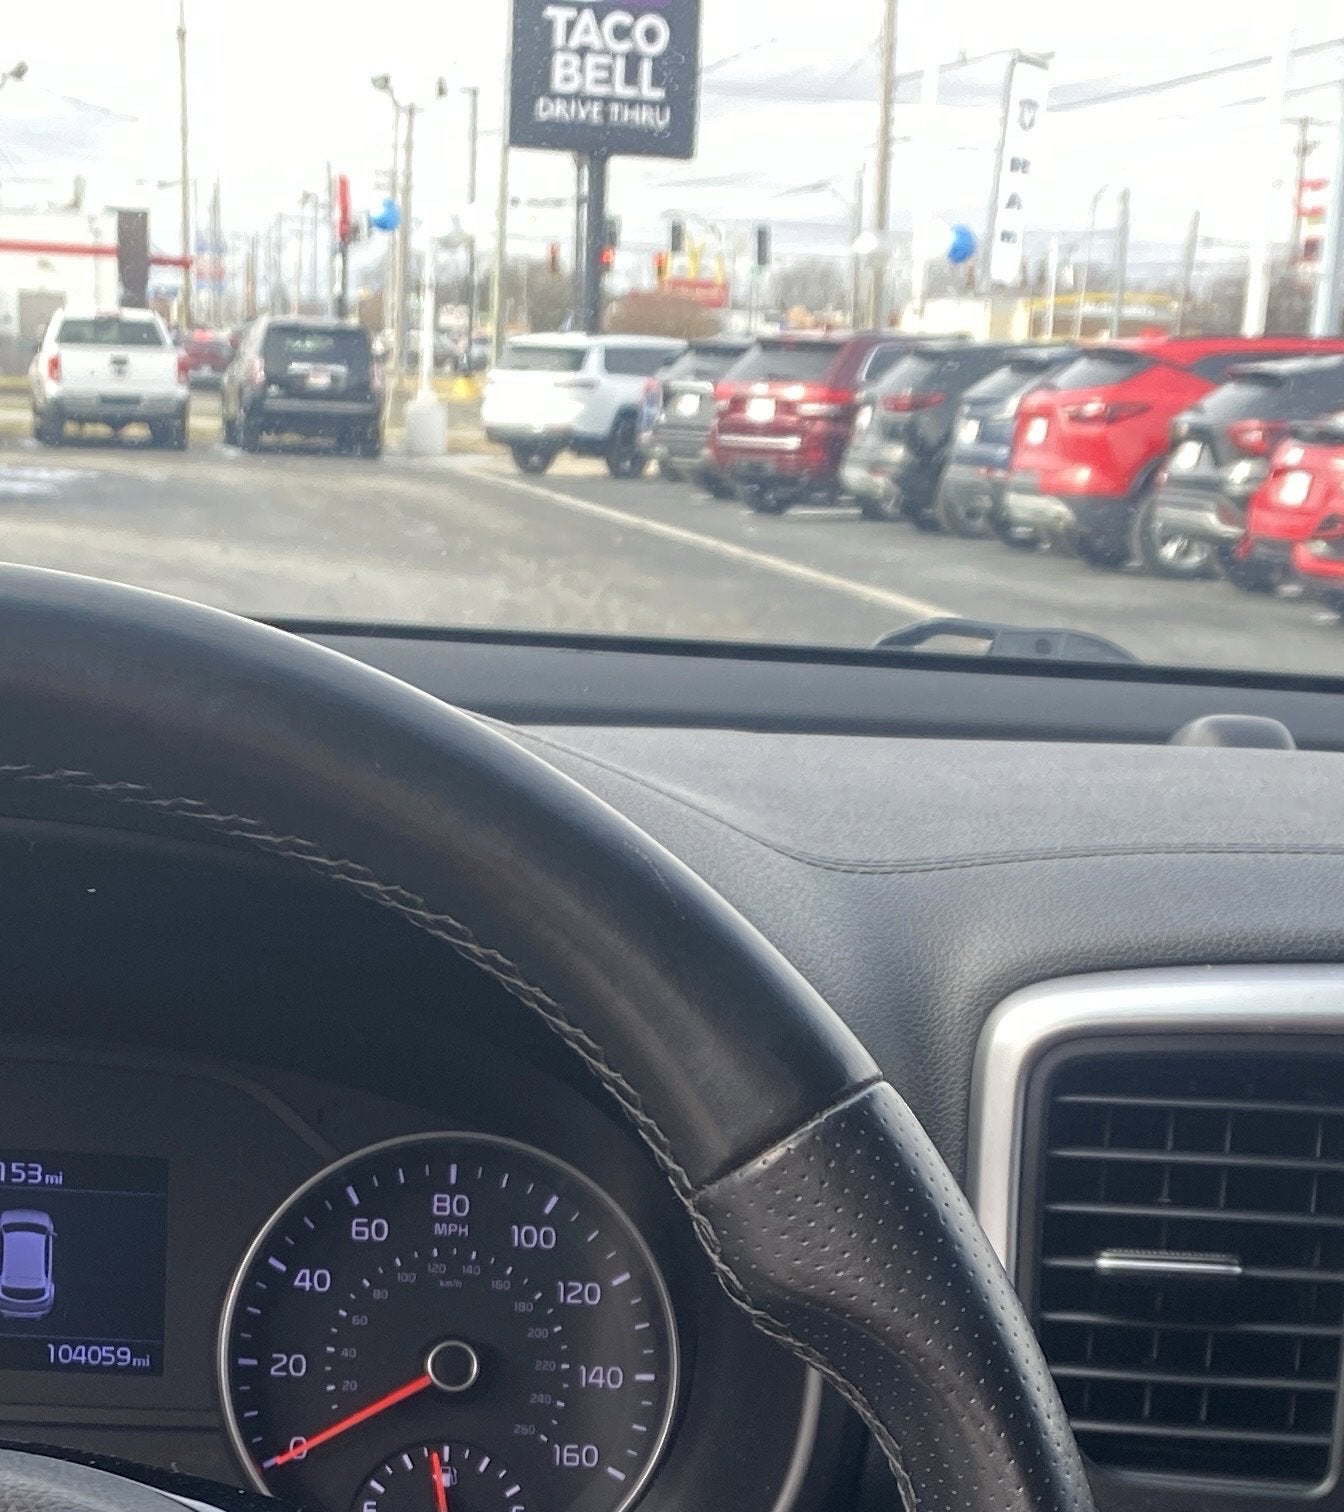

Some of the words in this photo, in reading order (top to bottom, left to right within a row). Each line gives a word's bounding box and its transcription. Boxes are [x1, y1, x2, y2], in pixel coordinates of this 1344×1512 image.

[542, 6, 671, 56] TACO
[551, 50, 666, 100] BELL
[535, 96, 605, 125] DRIVE
[609, 101, 671, 131] THRU
[432, 1194, 470, 1216] 80
[351, 1218, 389, 1242] 60
[434, 1223, 469, 1238] MPH
[511, 1226, 557, 1249] 100
[428, 1263, 446, 1274] 120
[462, 1265, 481, 1276] 140
[293, 1269, 331, 1292] 40
[397, 1272, 417, 1284] 100
[491, 1280, 511, 1290] 160
[373, 1288, 389, 1300] 80
[557, 1281, 601, 1305] 120
[514, 1302, 533, 1313] 180
[352, 1315, 368, 1326] 60
[528, 1328, 549, 1339] 200
[341, 1348, 356, 1359] 40
[270, 1354, 307, 1377] 20
[535, 1360, 556, 1371] 220
[579, 1366, 623, 1389] 140
[342, 1380, 358, 1391] 20
[530, 1394, 551, 1405] 240
[289, 1436, 308, 1460] 0
[554, 1444, 598, 1467] 160
